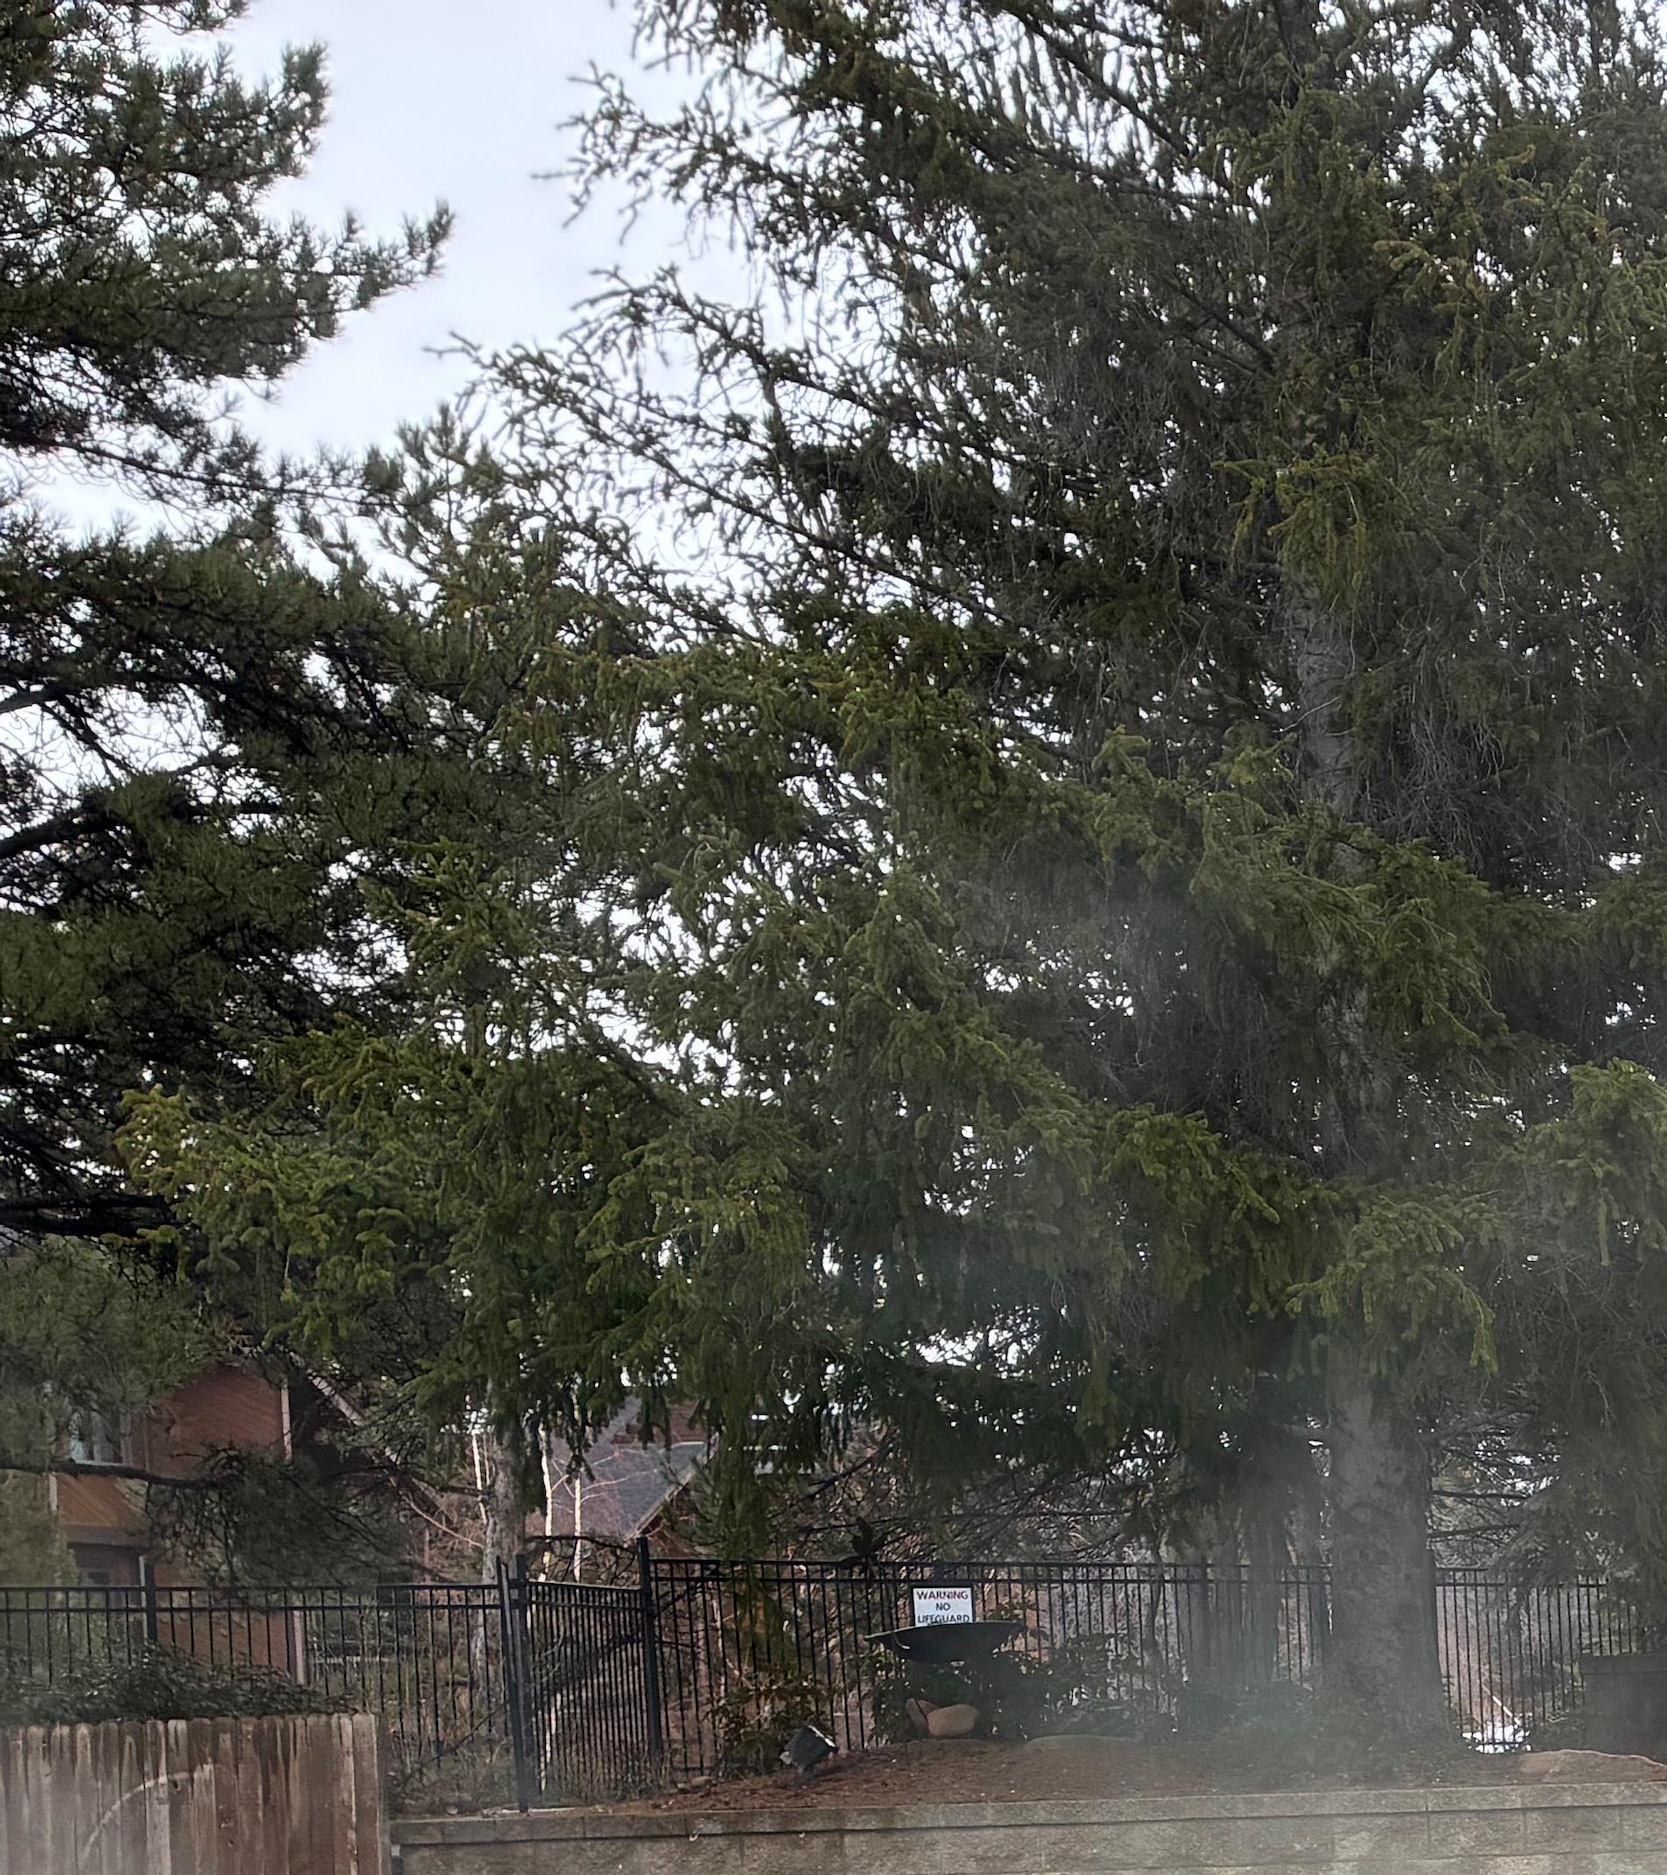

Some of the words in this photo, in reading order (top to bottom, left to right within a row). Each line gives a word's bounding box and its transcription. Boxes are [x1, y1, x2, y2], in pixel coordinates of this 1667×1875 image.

[917, 1590, 969, 1600] WARNING
[935, 1602, 951, 1611] NO
[917, 1614, 970, 1624] LIFEGUARD
